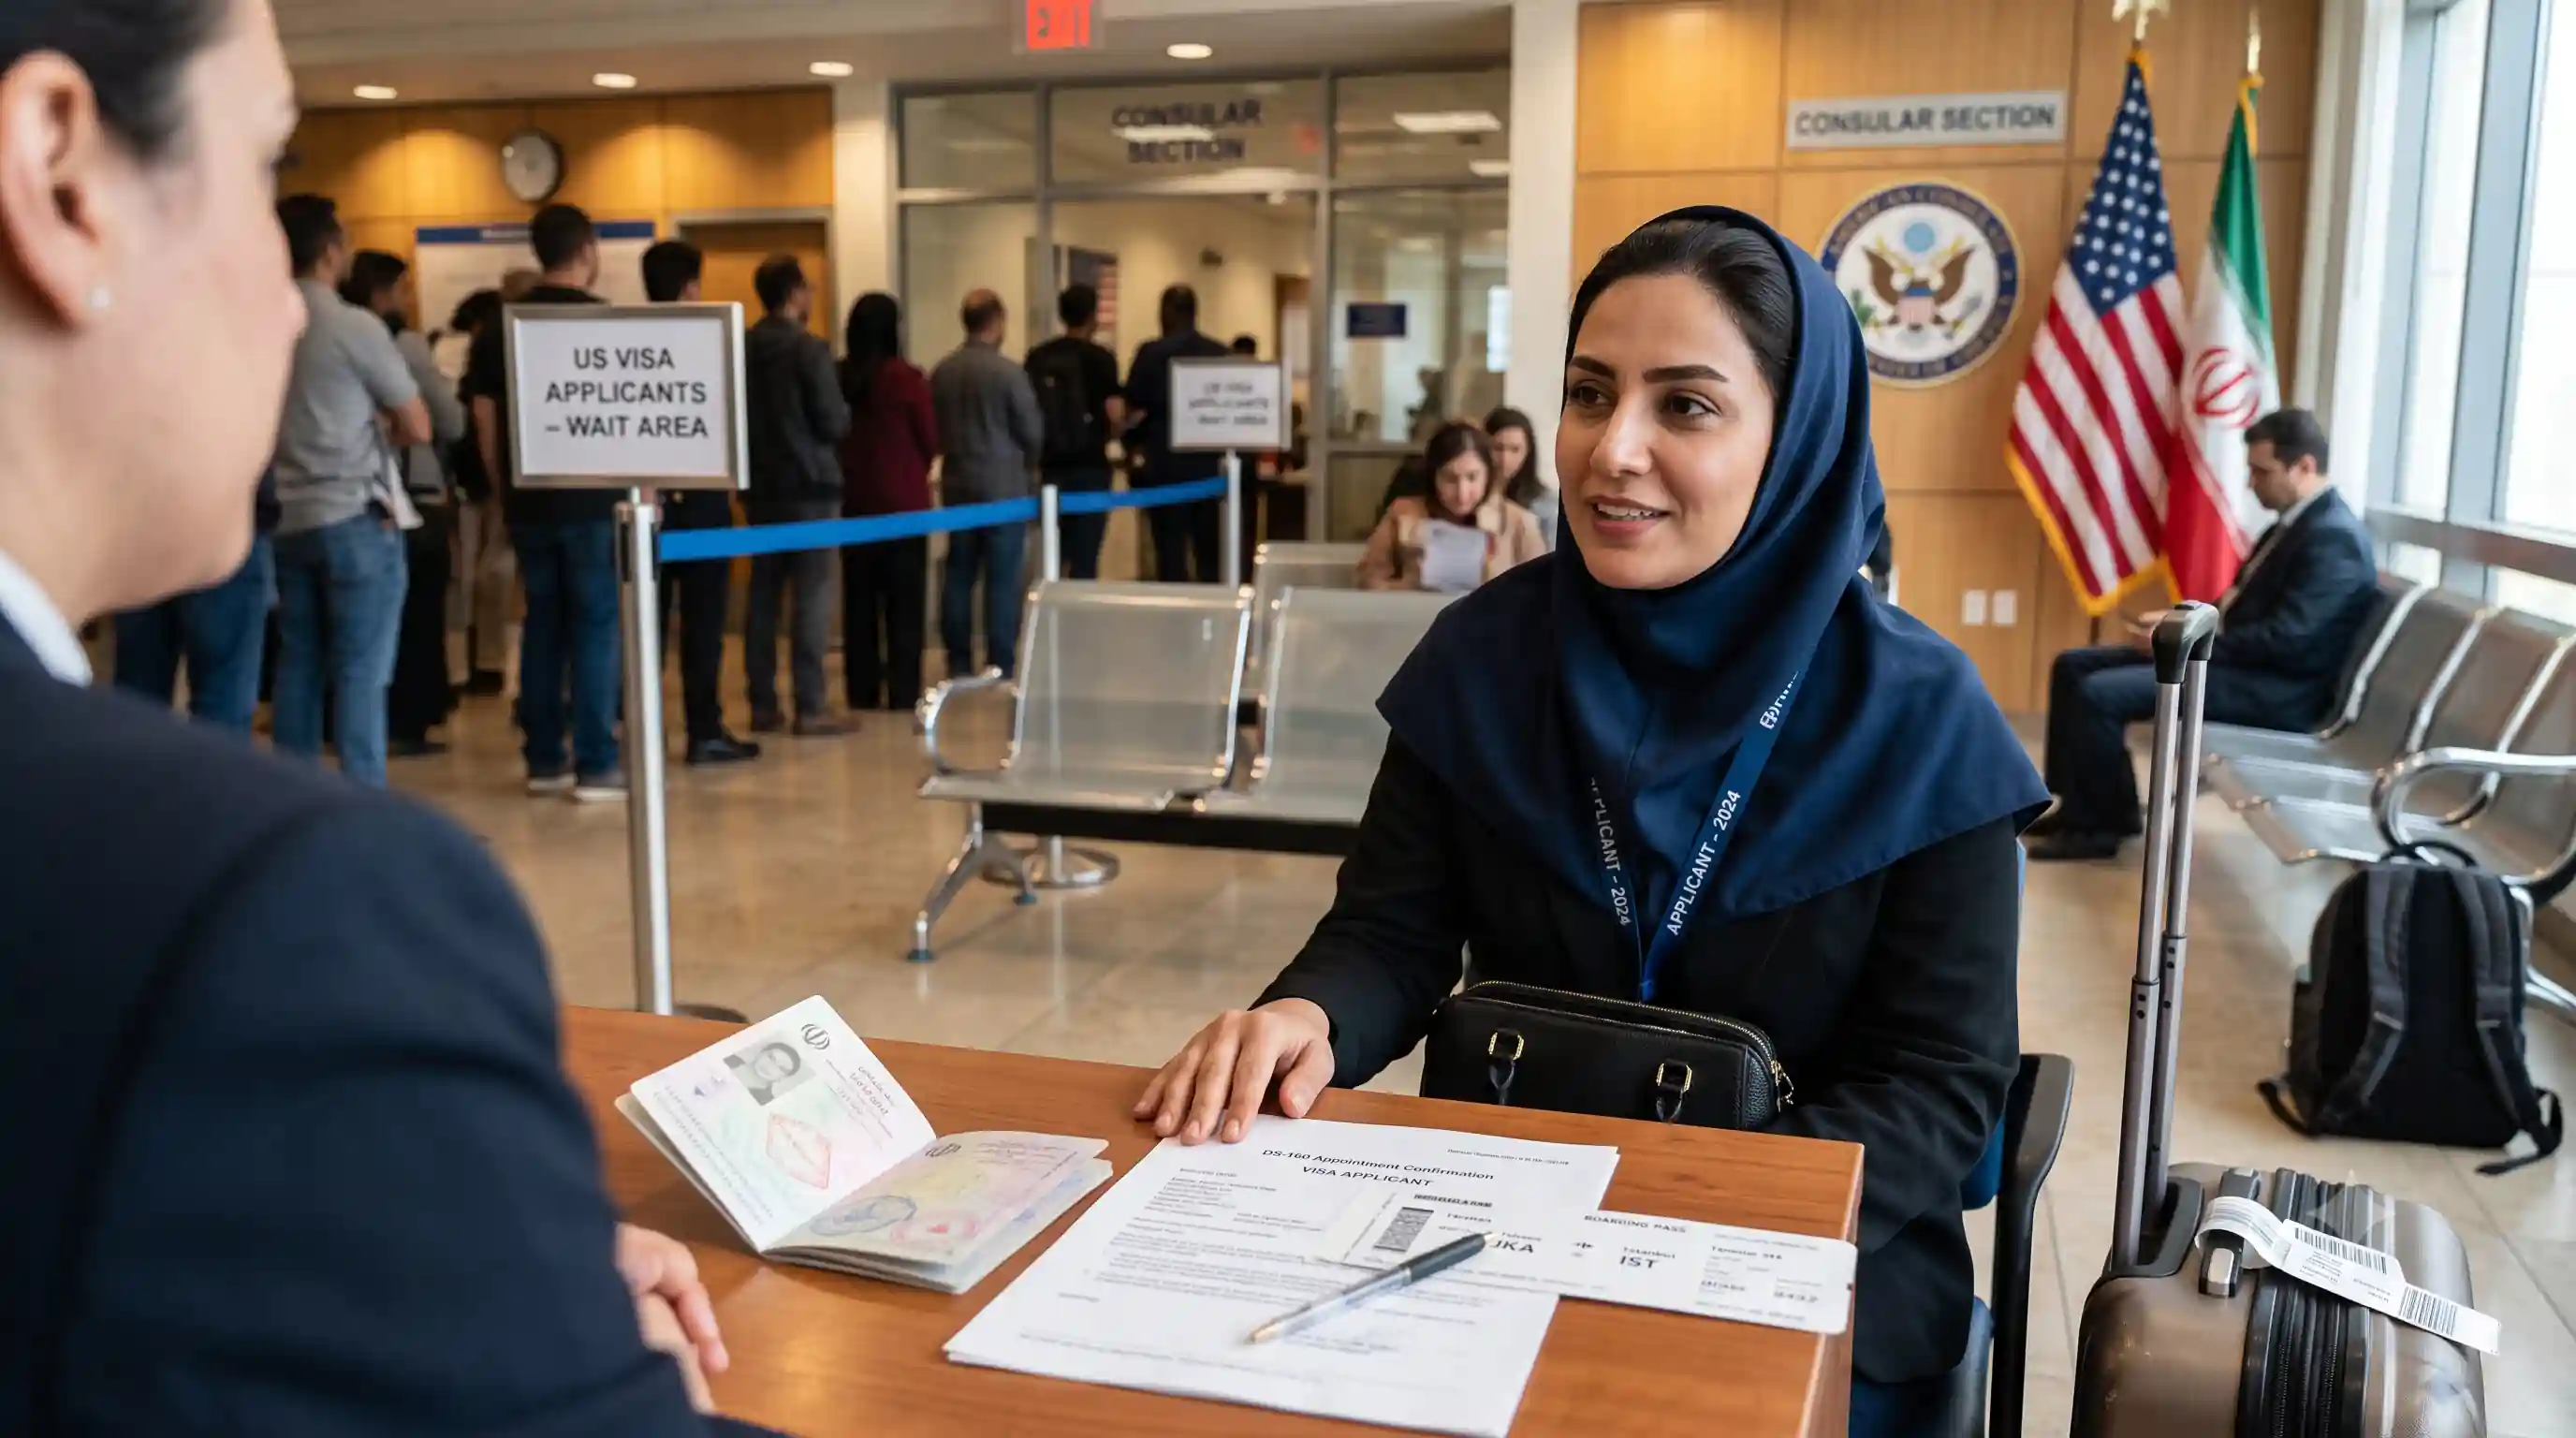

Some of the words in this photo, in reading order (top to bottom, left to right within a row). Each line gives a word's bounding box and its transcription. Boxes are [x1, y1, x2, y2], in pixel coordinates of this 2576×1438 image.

[1795, 107, 1934, 135] CONSULAR
[1940, 103, 2056, 131] SECTION
[573, 347, 608, 370] US
[614, 347, 676, 371] VISA
[545, 380, 708, 404] APPLICANTS
[565, 416, 631, 438] WAIT
[637, 416, 710, 439] AREA
[1666, 842, 1717, 936] APPLICANT
[1713, 789, 1742, 831] 2024
[1611, 887, 1632, 927] 2024
[1261, 1150, 1310, 1161] DS-160
[1312, 1154, 1400, 1171] Appointment
[1403, 1164, 1495, 1181] Confirmation
[1301, 1166, 1338, 1177] VISA
[1340, 1170, 1435, 1187] APPLICANT
[1619, 1255, 1661, 1269] IST
